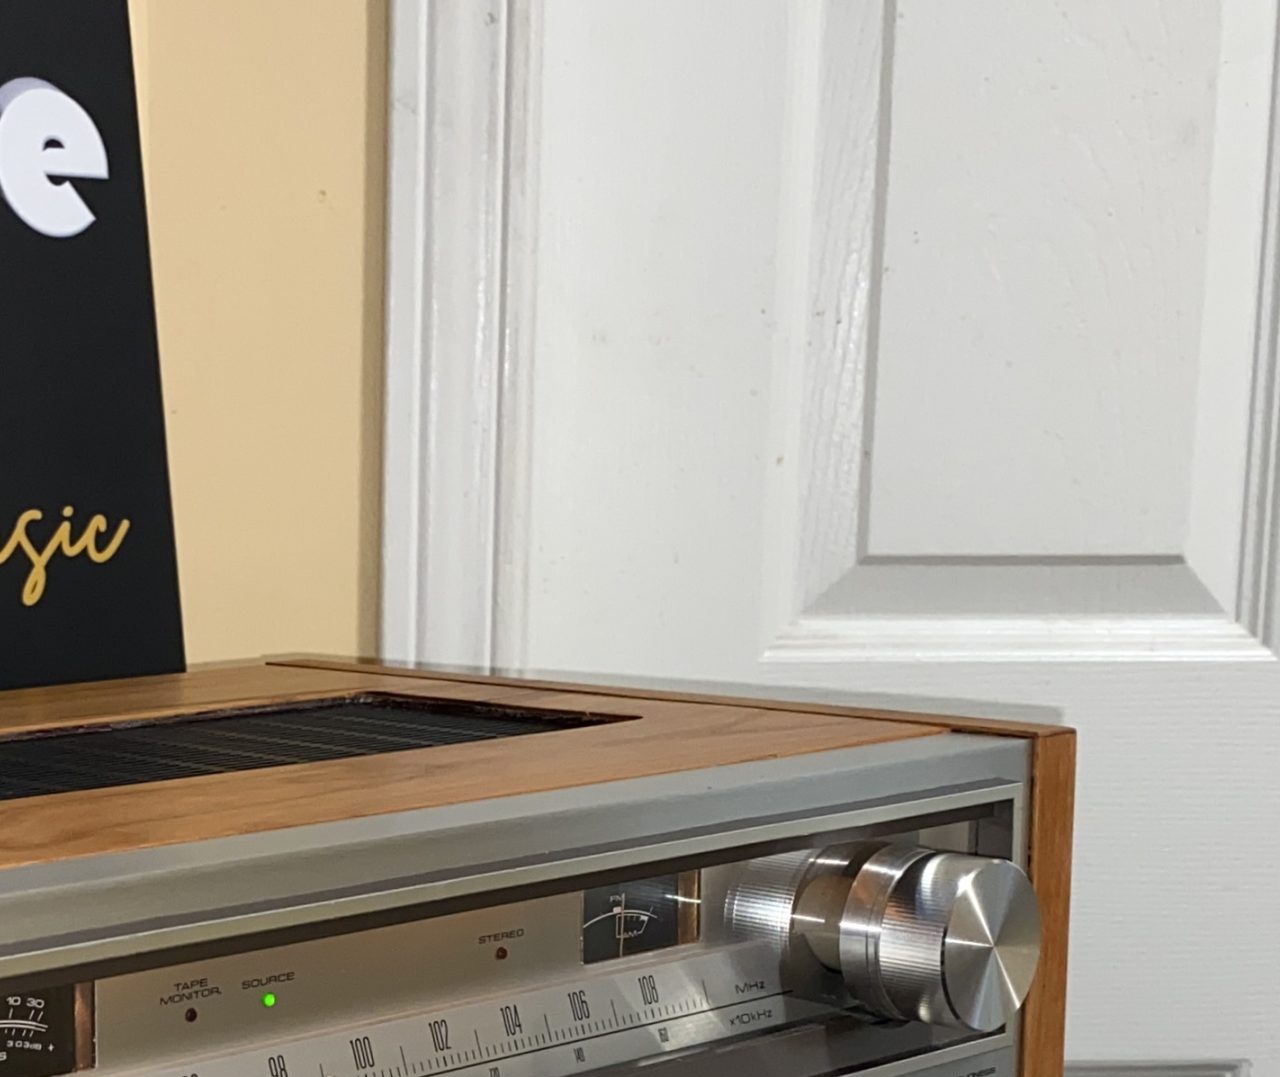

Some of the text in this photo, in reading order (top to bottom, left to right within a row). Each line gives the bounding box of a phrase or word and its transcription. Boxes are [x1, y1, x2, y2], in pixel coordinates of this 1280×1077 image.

[478, 928, 526, 946] STEREO
[173, 977, 209, 993] TAPE
[242, 971, 296, 990] SOURCE
[6, 996, 21, 1006] 10
[26, 997, 45, 1009] 30
[160, 986, 221, 1006] MONITOR
[349, 1035, 375, 1071] 100
[428, 1018, 452, 1053] 102
[499, 1004, 522, 1037] 104
[567, 989, 590, 1022] 106
[638, 975, 659, 1005] 108
[734, 981, 766, 994] MHz
